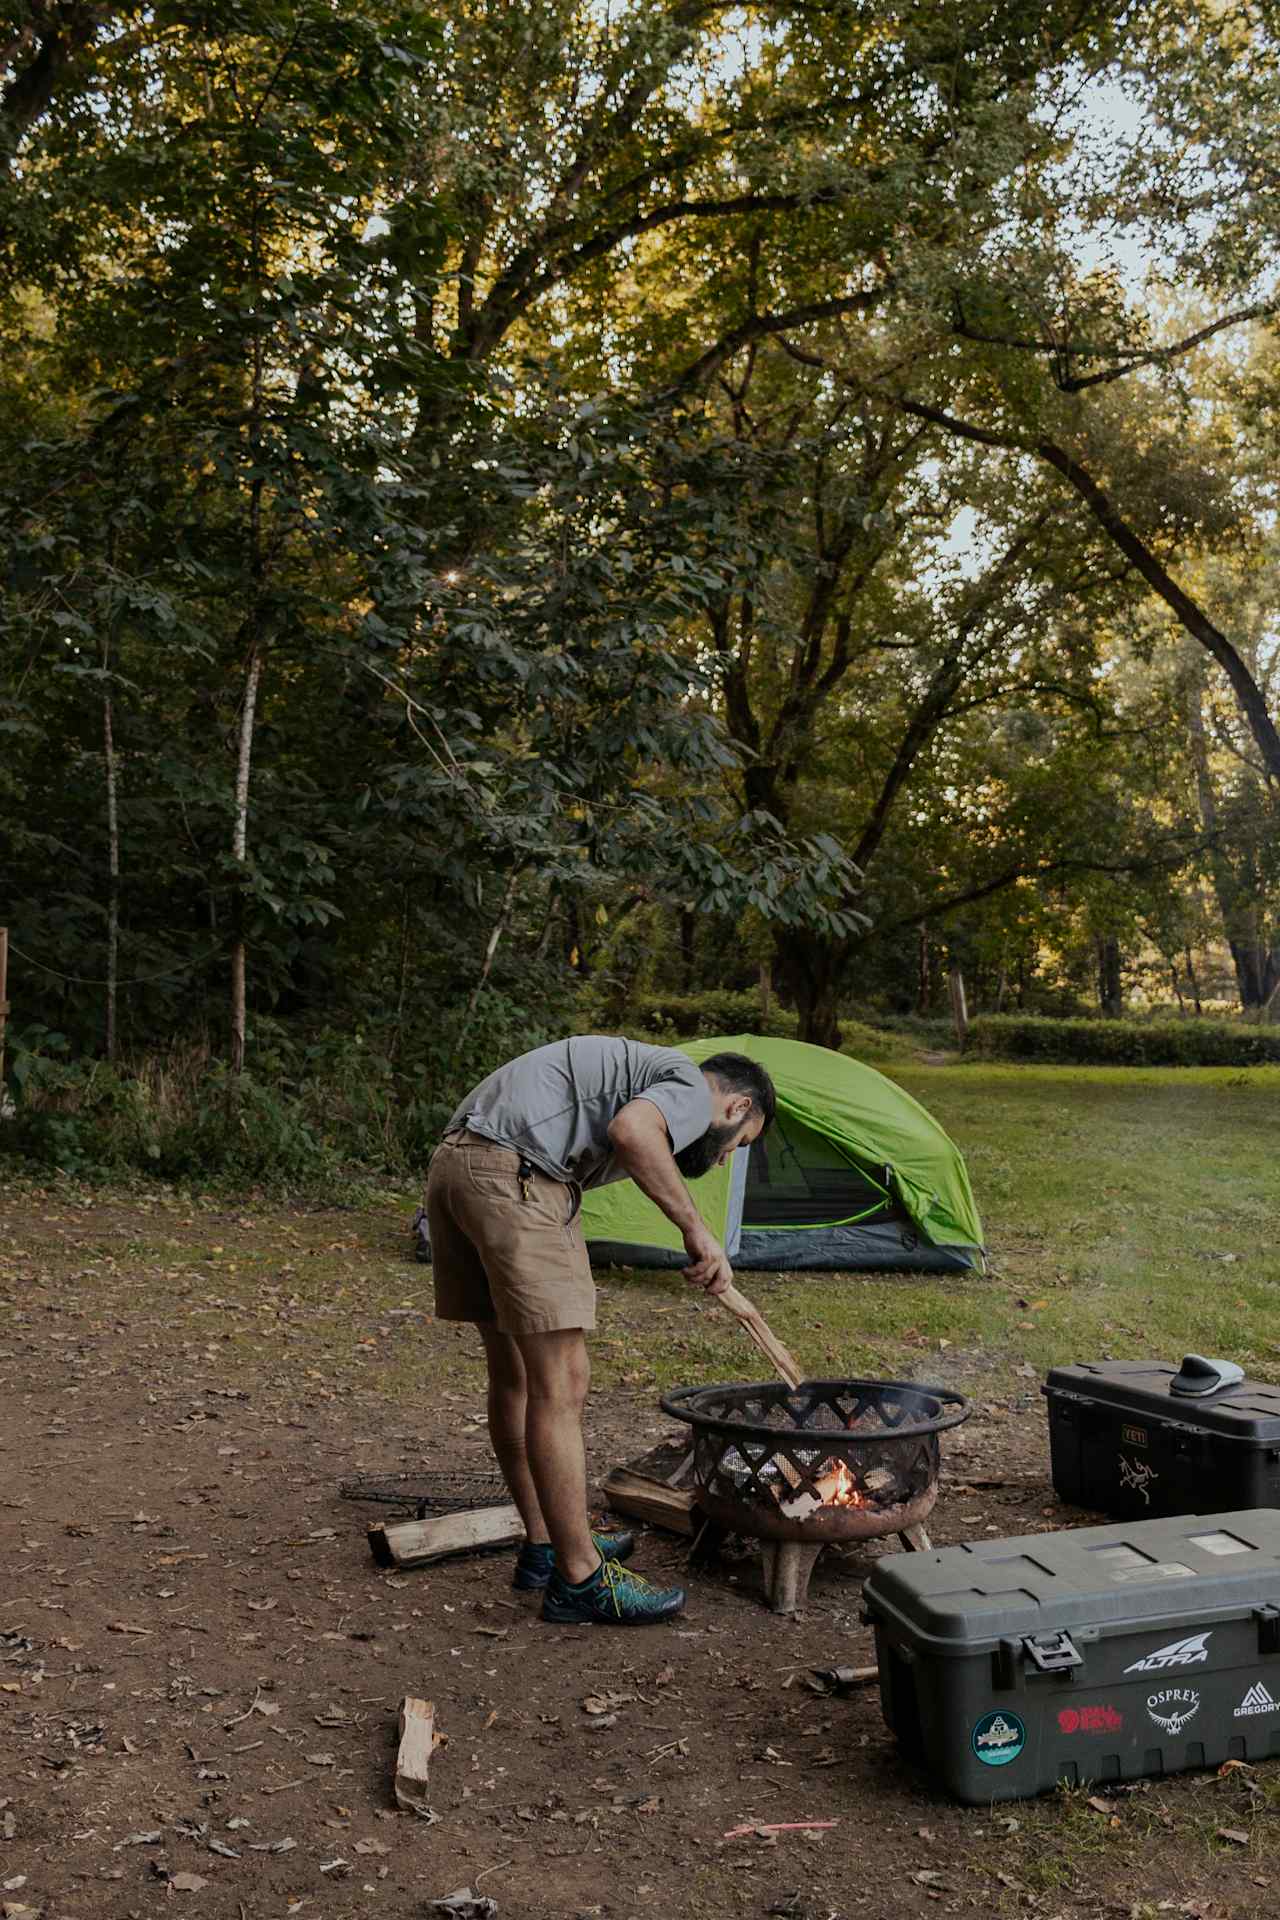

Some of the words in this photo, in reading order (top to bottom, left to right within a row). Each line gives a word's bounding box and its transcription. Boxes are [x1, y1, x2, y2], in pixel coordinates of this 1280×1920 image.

[1126, 1428, 1145, 1443] YETI
[1123, 1650, 1208, 1674] ALTRA
[1147, 1689, 1199, 1708] OSPREY
[1233, 1703, 1280, 1717] GREGORY
